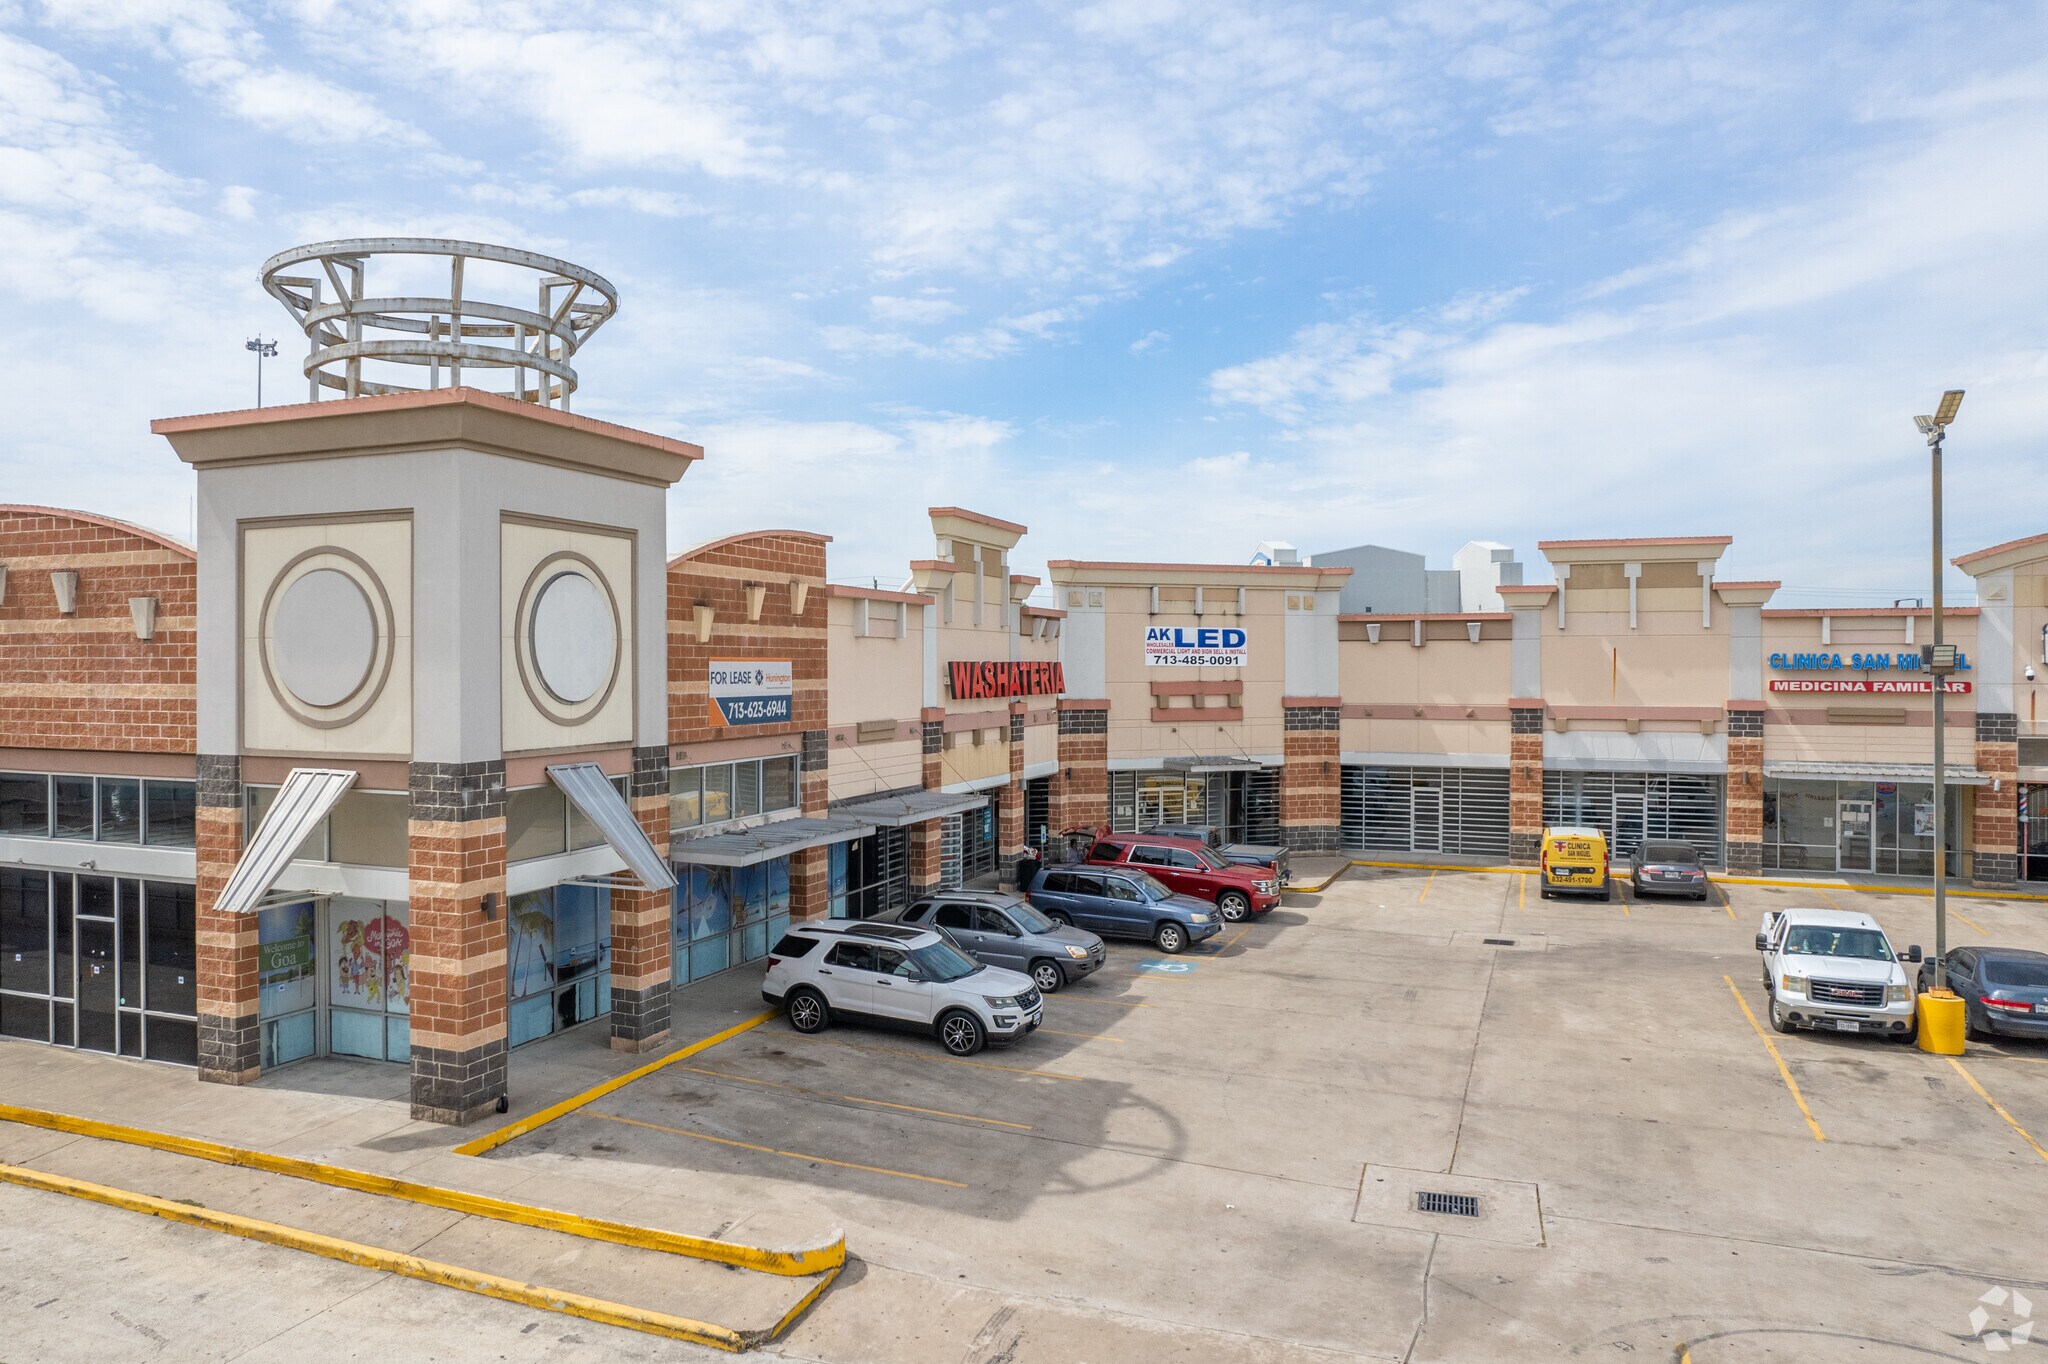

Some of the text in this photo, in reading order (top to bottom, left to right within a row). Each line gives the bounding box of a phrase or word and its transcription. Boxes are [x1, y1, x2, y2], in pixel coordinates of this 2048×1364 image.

[1147, 628, 1246, 648] AK LED
[1154, 655, 1239, 665] 713-485-0091
[1769, 652, 1843, 670] CLINICA
[1851, 653, 1890, 670] SAN
[711, 671, 752, 685] FOR LEASE
[766, 673, 791, 685] Hunington
[949, 661, 1066, 699] WASHATERIA
[1774, 681, 1867, 692] MEDICINA
[728, 700, 787, 719] 713-623-6944
[1567, 842, 1591, 850] CLINICA
[1551, 876, 1593, 884] 832-491-1700
[263, 940, 305, 954] Welcome to
[271, 953, 297, 968] Goa
[1831, 988, 1864, 998] GMC
